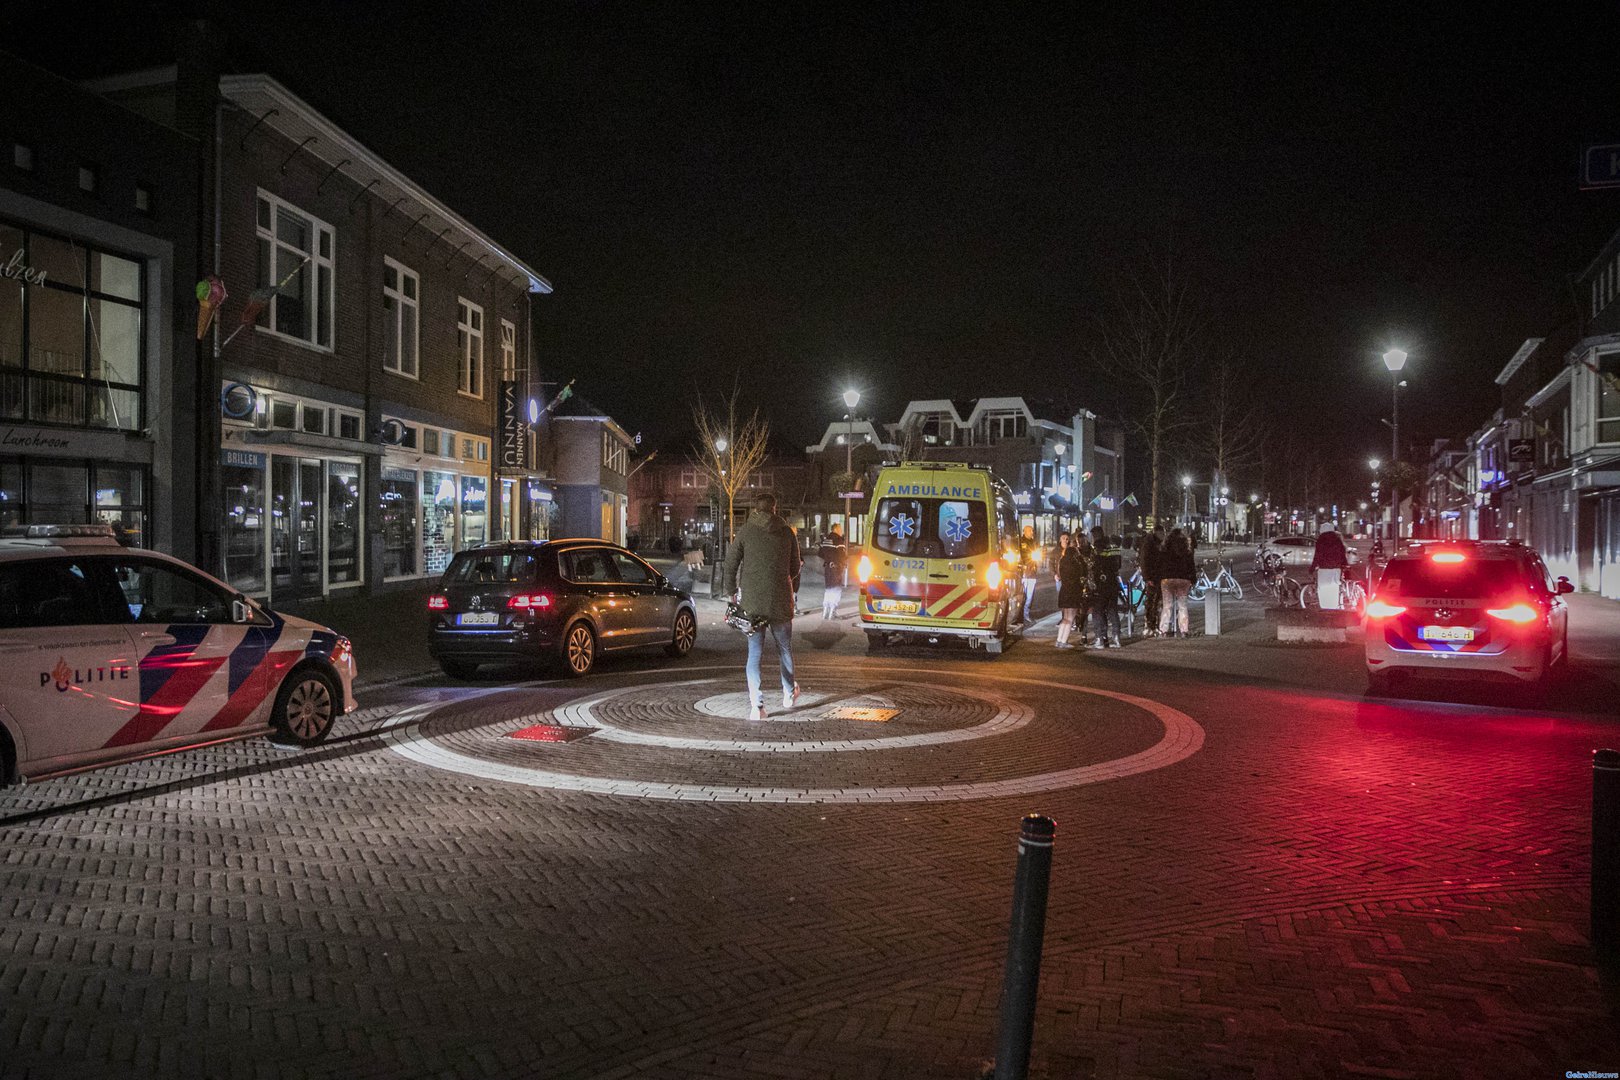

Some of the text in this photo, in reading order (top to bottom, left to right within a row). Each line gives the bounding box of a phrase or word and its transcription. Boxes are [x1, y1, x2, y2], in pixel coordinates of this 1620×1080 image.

[516, 421, 524, 465] MANNEN
[227, 451, 258, 466] BRILLEN
[888, 485, 981, 498] AMBULANCE
[892, 559, 925, 570] 07122
[40, 666, 128, 692] POLITIE
